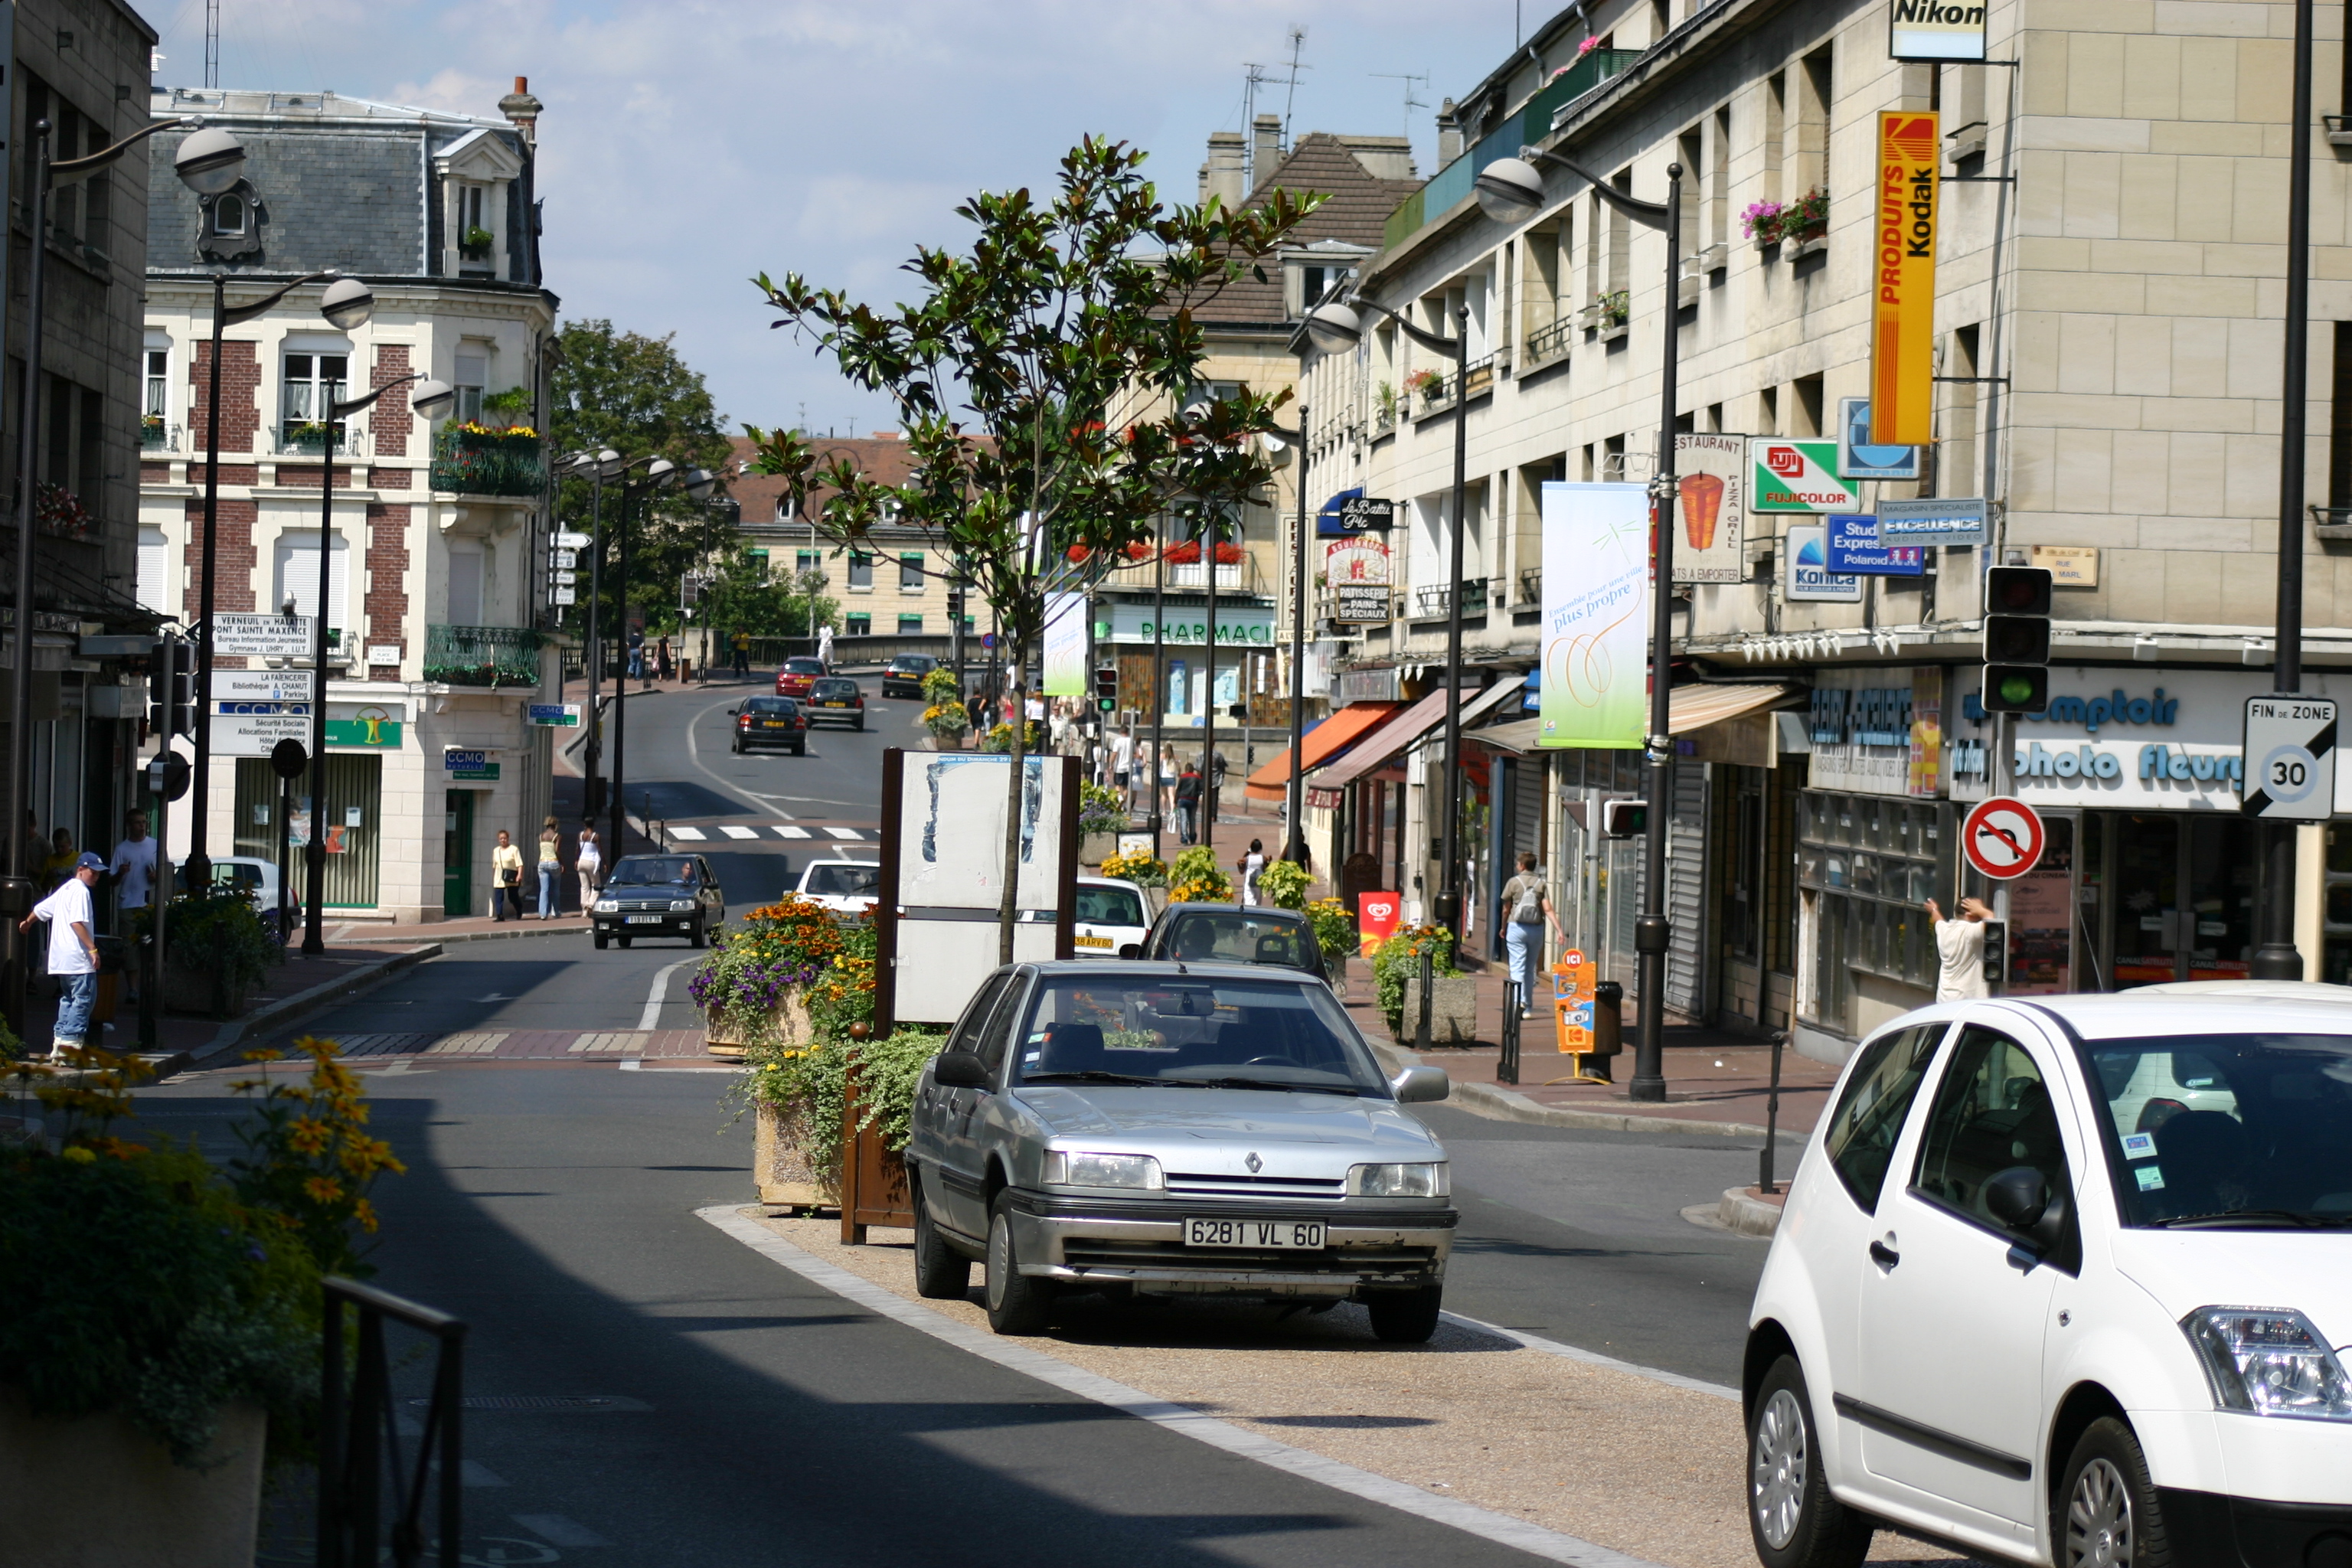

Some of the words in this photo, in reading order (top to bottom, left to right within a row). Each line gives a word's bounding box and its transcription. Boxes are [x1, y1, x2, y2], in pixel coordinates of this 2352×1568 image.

[1893, 0, 1984, 24] Nikon
[1907, 167, 1932, 258] Kodak
[1880, 165, 1904, 305] PRODUITS
[1674, 436, 1740, 455] ESTAURANT
[1727, 475, 1738, 508] PIZZA
[1766, 493, 1846, 504] FUJICOLOR
[1727, 516, 1739, 549] GRILL
[1845, 522, 1877, 537] Stud
[1884, 517, 1981, 534] EXCELLENCE
[1844, 554, 1888, 566] Polaroid
[1689, 568, 1696, 580] A
[1697, 568, 1738, 580] EMPORTER
[1795, 569, 1856, 585] Konica
[1340, 588, 1389, 599] PATISSERIE
[1548, 595, 1586, 619] Ensemble
[1587, 584, 1607, 600] pour
[1609, 576, 1624, 588] une
[1625, 566, 1642, 579] ville
[1351, 600, 1377, 609] PAINS
[1553, 609, 1583, 634] plus
[1586, 584, 1631, 617] propre
[221, 616, 259, 625] VERNEUIL
[274, 618, 306, 626] HALATTE
[212, 626, 233, 634] PONT
[237, 626, 263, 635] SAINTE
[268, 627, 306, 635] MAXENCE
[1142, 623, 1269, 642] PHARMACI
[228, 644, 257, 653] Gymnase
[284, 692, 308, 701] Parking
[531, 706, 563, 714] CCMO
[2021, 688, 2178, 732] mptoir
[2252, 704, 2274, 717] FIN
[2292, 706, 2331, 720] ZONE
[447, 752, 484, 763] CCMO
[2272, 762, 2305, 786] 30
[1102, 939, 1112, 948] 60
[1566, 955, 1580, 964] ICI
[1192, 1221, 1244, 1244] 6281
[1258, 1223, 1282, 1246] VL
[1294, 1224, 1320, 1246] 60
